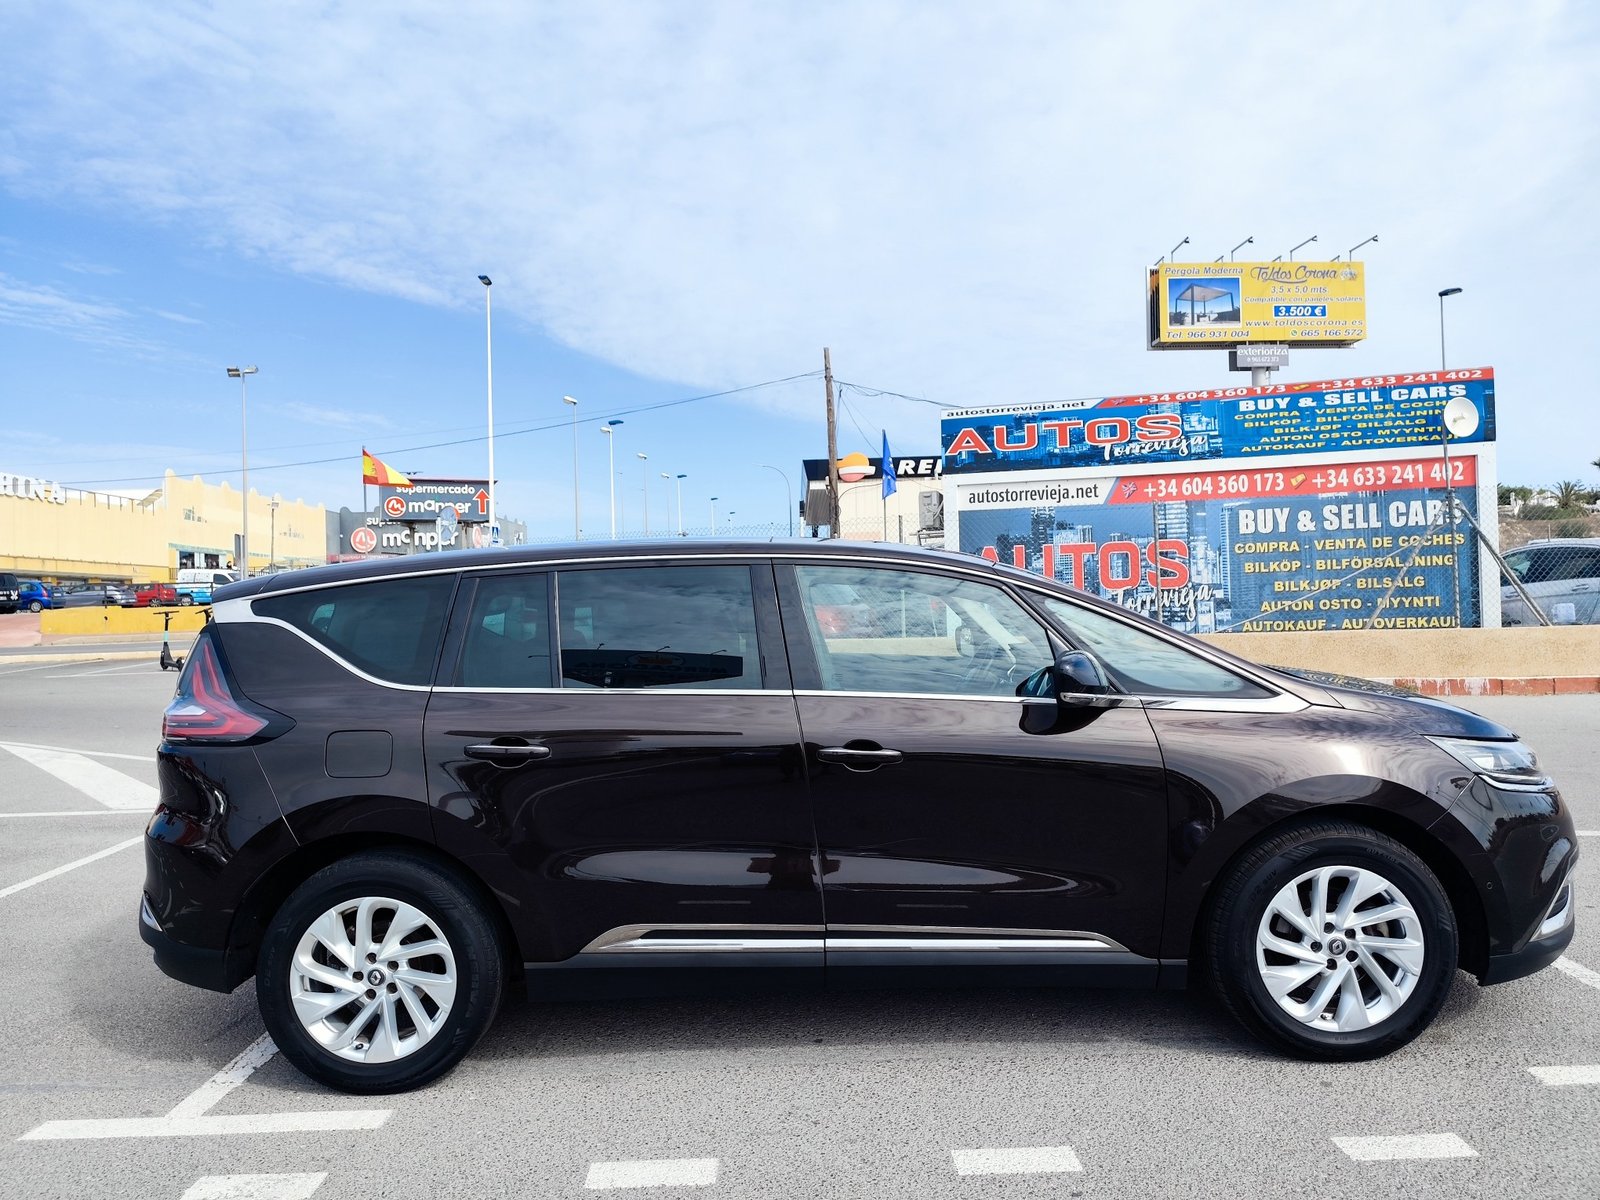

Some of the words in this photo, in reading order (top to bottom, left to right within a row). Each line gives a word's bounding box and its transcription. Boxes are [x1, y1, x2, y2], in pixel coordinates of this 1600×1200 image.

[1164, 266, 1200, 276] Pergola
[1203, 266, 1244, 274] Moderna
[1250, 265, 1292, 283] Toldos
[1295, 265, 1338, 280] Corona
[1278, 306, 1312, 316] 3.500
[1314, 306, 1323, 316] €
[1319, 378, 1356, 390] +34
[1361, 375, 1397, 387] 633
[1403, 373, 1438, 383] 241
[1445, 369, 1483, 379] 402
[1134, 393, 1171, 404] +34
[1175, 390, 1209, 401] 604
[1214, 387, 1247, 398] 360
[1253, 384, 1286, 395] 173
[1239, 397, 1291, 412] BUY
[1298, 396, 1317, 408] &
[1325, 389, 1384, 406] SELL
[1391, 384, 1466, 401] CARS
[946, 400, 1086, 417] autostorrevieja.net
[1234, 411, 1300, 420] COMPRA
[1315, 405, 1368, 415] VENTA
[1373, 403, 1395, 411] DE
[1400, 400, 1448, 408] COCH
[1244, 416, 1301, 428] BILKÖP
[1316, 409, 1444, 423] BILFÖRSÄLJNIN
[1273, 424, 1341, 434] BILKJØP
[1357, 419, 1427, 429] BILSALG
[945, 413, 1183, 456] AUTOS
[1260, 433, 1314, 443] AUTON
[1319, 430, 1363, 439] OSTO
[1377, 425, 1442, 436] MYYNTI
[1100, 434, 1208, 461] Torrevieja
[1241, 441, 1327, 453] AUTOKAUF
[1143, 478, 1178, 498] +34
[1182, 476, 1213, 496] 604
[1217, 474, 1249, 494] 360
[1254, 472, 1284, 492] 173
[1312, 467, 1348, 489] +34
[1353, 465, 1386, 485] 633
[1391, 463, 1424, 484] 241
[968, 483, 1099, 505] autostorrevieja.net
[1238, 507, 1290, 535] BUY
[1297, 510, 1316, 533] &
[1322, 503, 1382, 531] SELL
[1234, 541, 1300, 554] COMPRA
[1314, 537, 1367, 551] VENTA
[1372, 536, 1393, 548] DE
[1244, 558, 1301, 573] BILKÖP
[1356, 575, 1425, 589] BILSALG
[1260, 599, 1314, 612] AUTON
[1319, 597, 1363, 611] OSTO
[1242, 619, 1327, 632] AUTOKAUF
